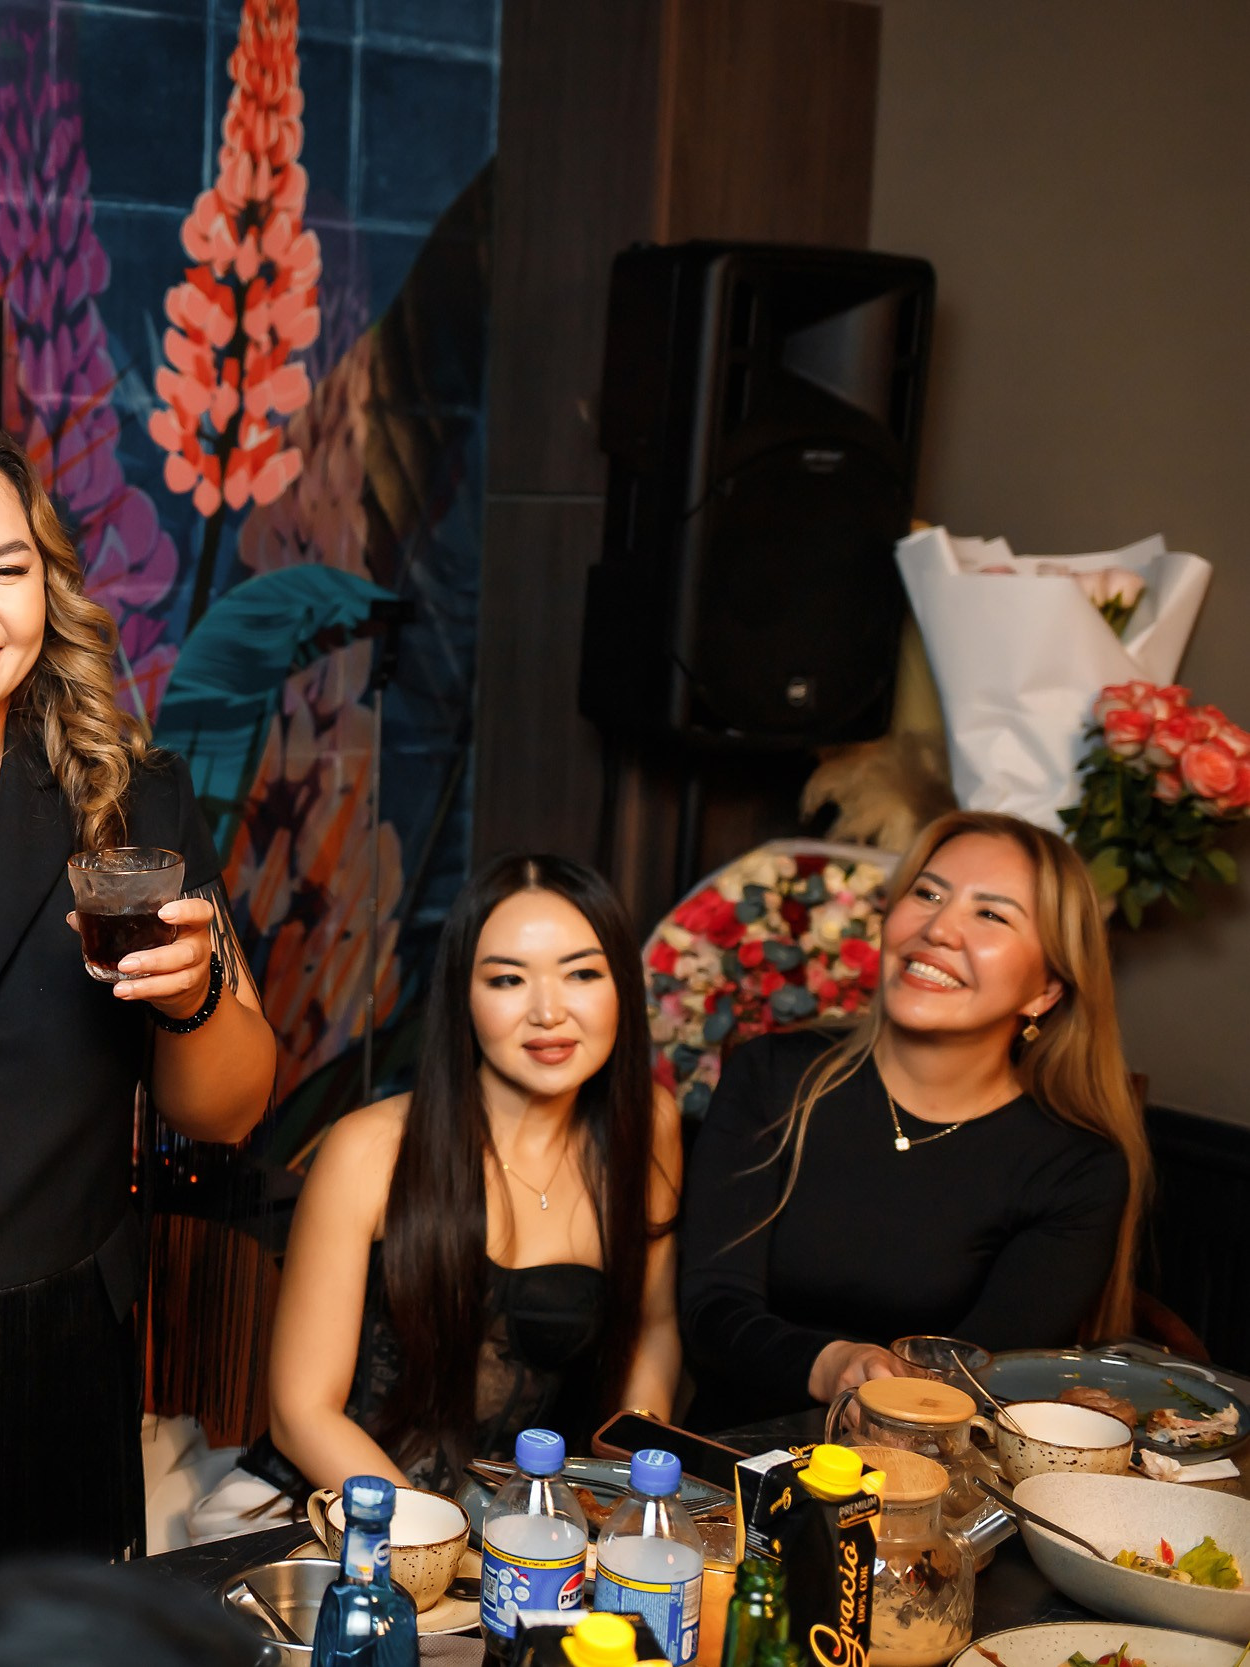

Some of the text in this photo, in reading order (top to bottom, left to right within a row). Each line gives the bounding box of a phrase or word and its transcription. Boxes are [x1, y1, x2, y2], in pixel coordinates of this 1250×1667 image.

[838, 1496, 877, 1519] PREMIUM
[810, 1541, 866, 1667] Gracio
[857, 1594, 867, 1624] 100%
